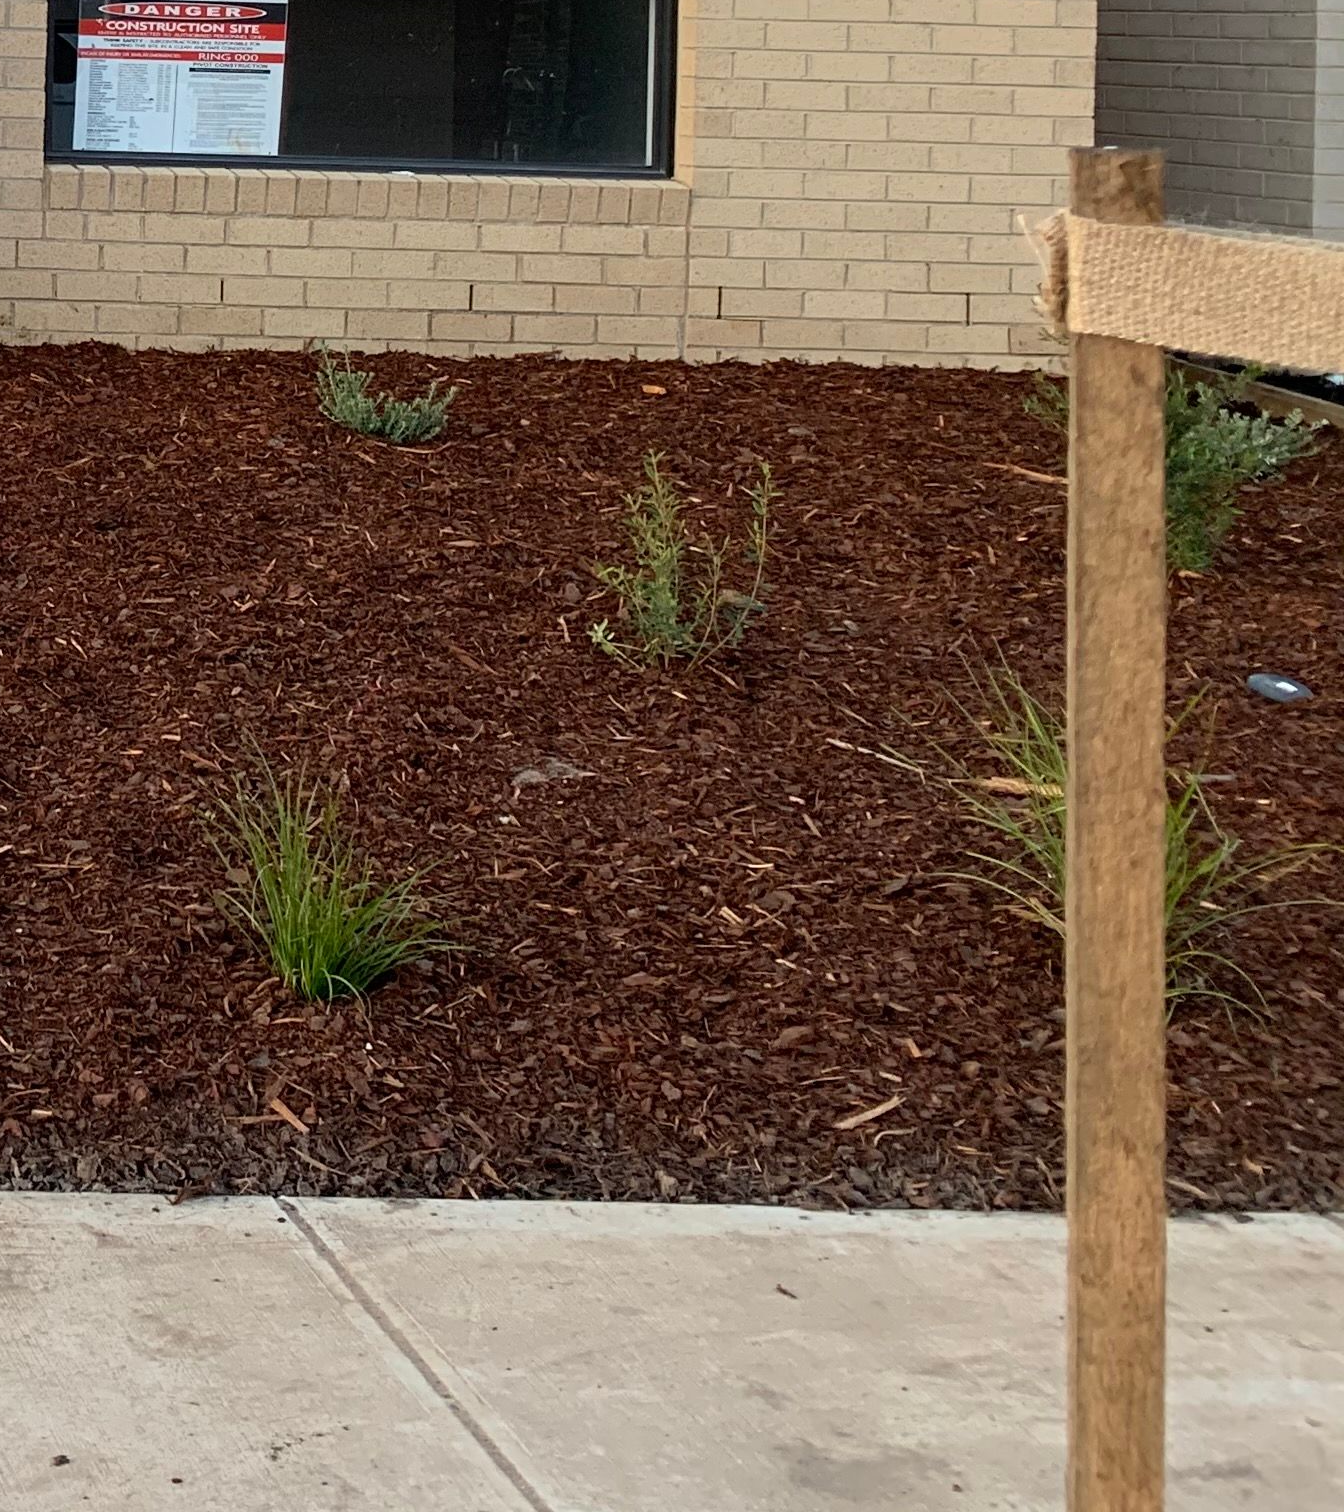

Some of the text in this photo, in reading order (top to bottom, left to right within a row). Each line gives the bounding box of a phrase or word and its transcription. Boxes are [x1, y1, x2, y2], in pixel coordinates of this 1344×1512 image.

[124, 5, 241, 17] DANGER
[106, 20, 260, 34] CONSTRUCTION SITE
[198, 52, 259, 61] RING 000
